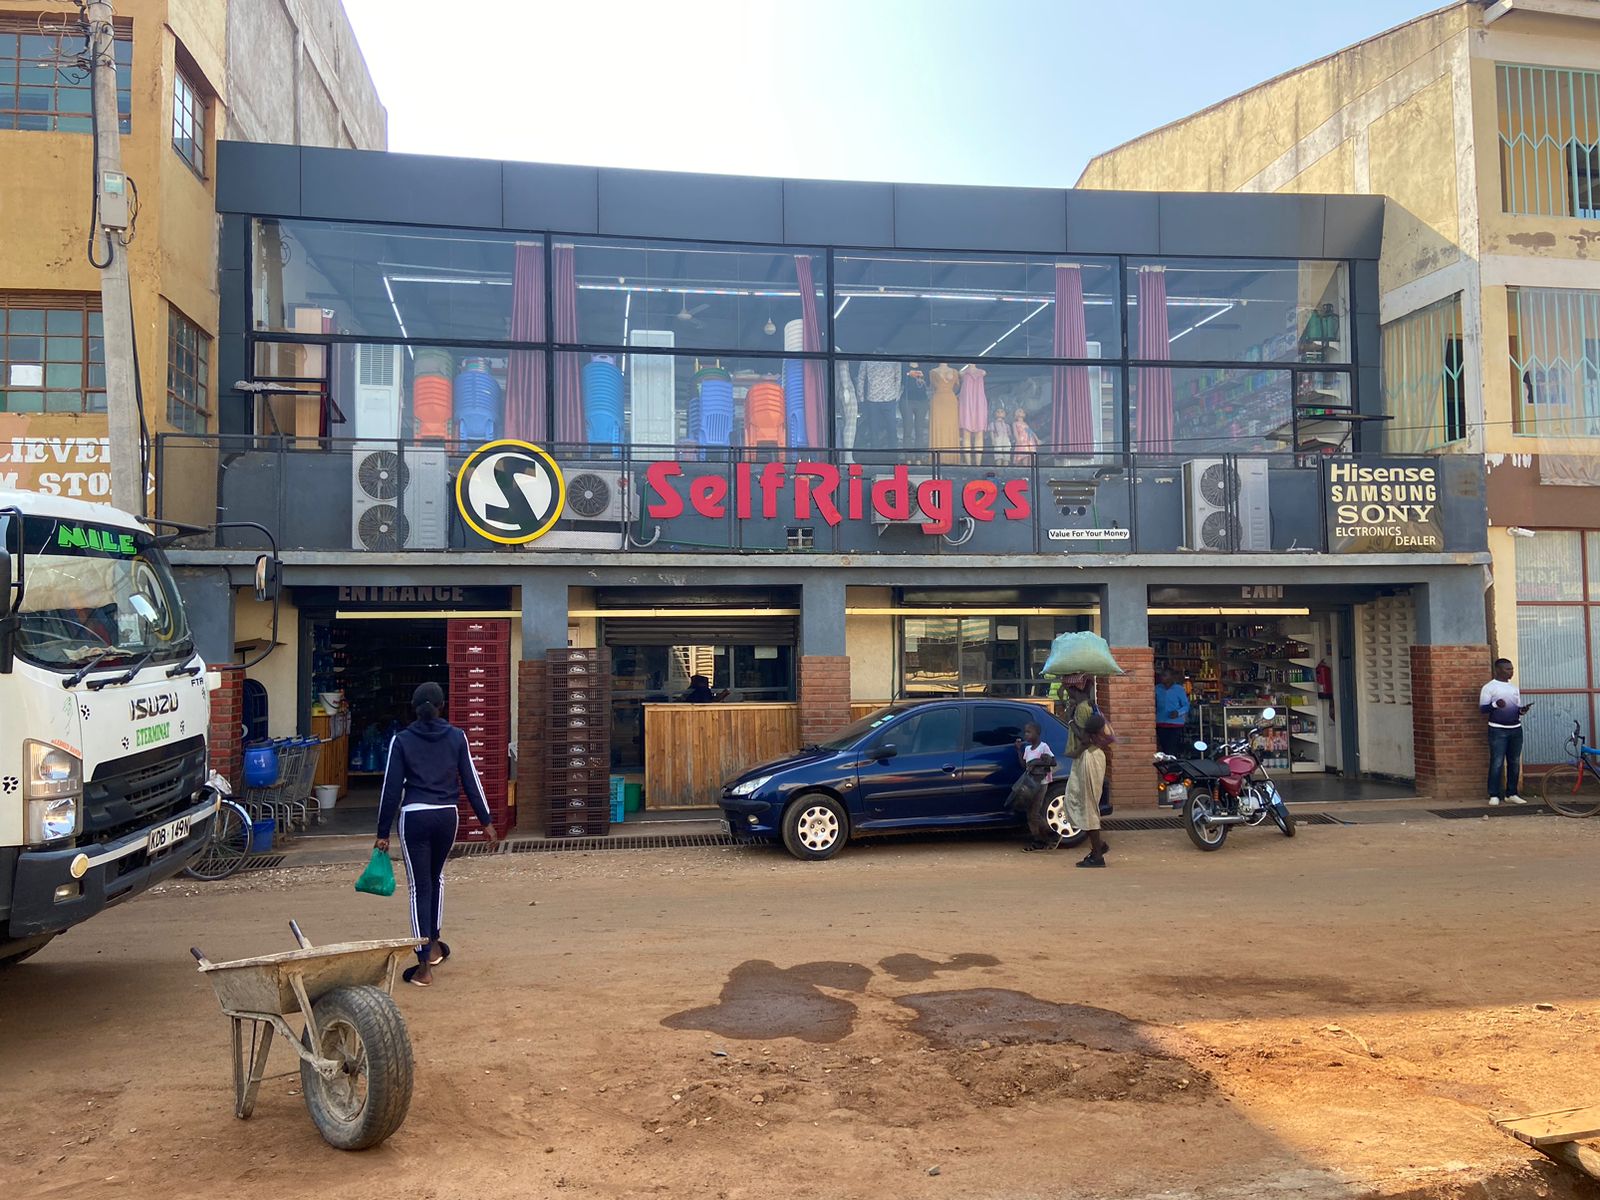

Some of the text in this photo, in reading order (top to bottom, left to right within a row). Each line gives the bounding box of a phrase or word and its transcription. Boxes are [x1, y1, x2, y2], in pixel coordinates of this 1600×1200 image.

[1330, 463, 1435, 482] Hisense
[646, 461, 1031, 535] SelfRidges
[1331, 484, 1437, 502] SAMSUNG
[1337, 504, 1434, 524] SONY
[58, 525, 137, 555] NILE
[1335, 526, 1402, 537] ELCTRONICS
[1395, 536, 1436, 546] DEALER
[129, 692, 179, 721] ISUZU
